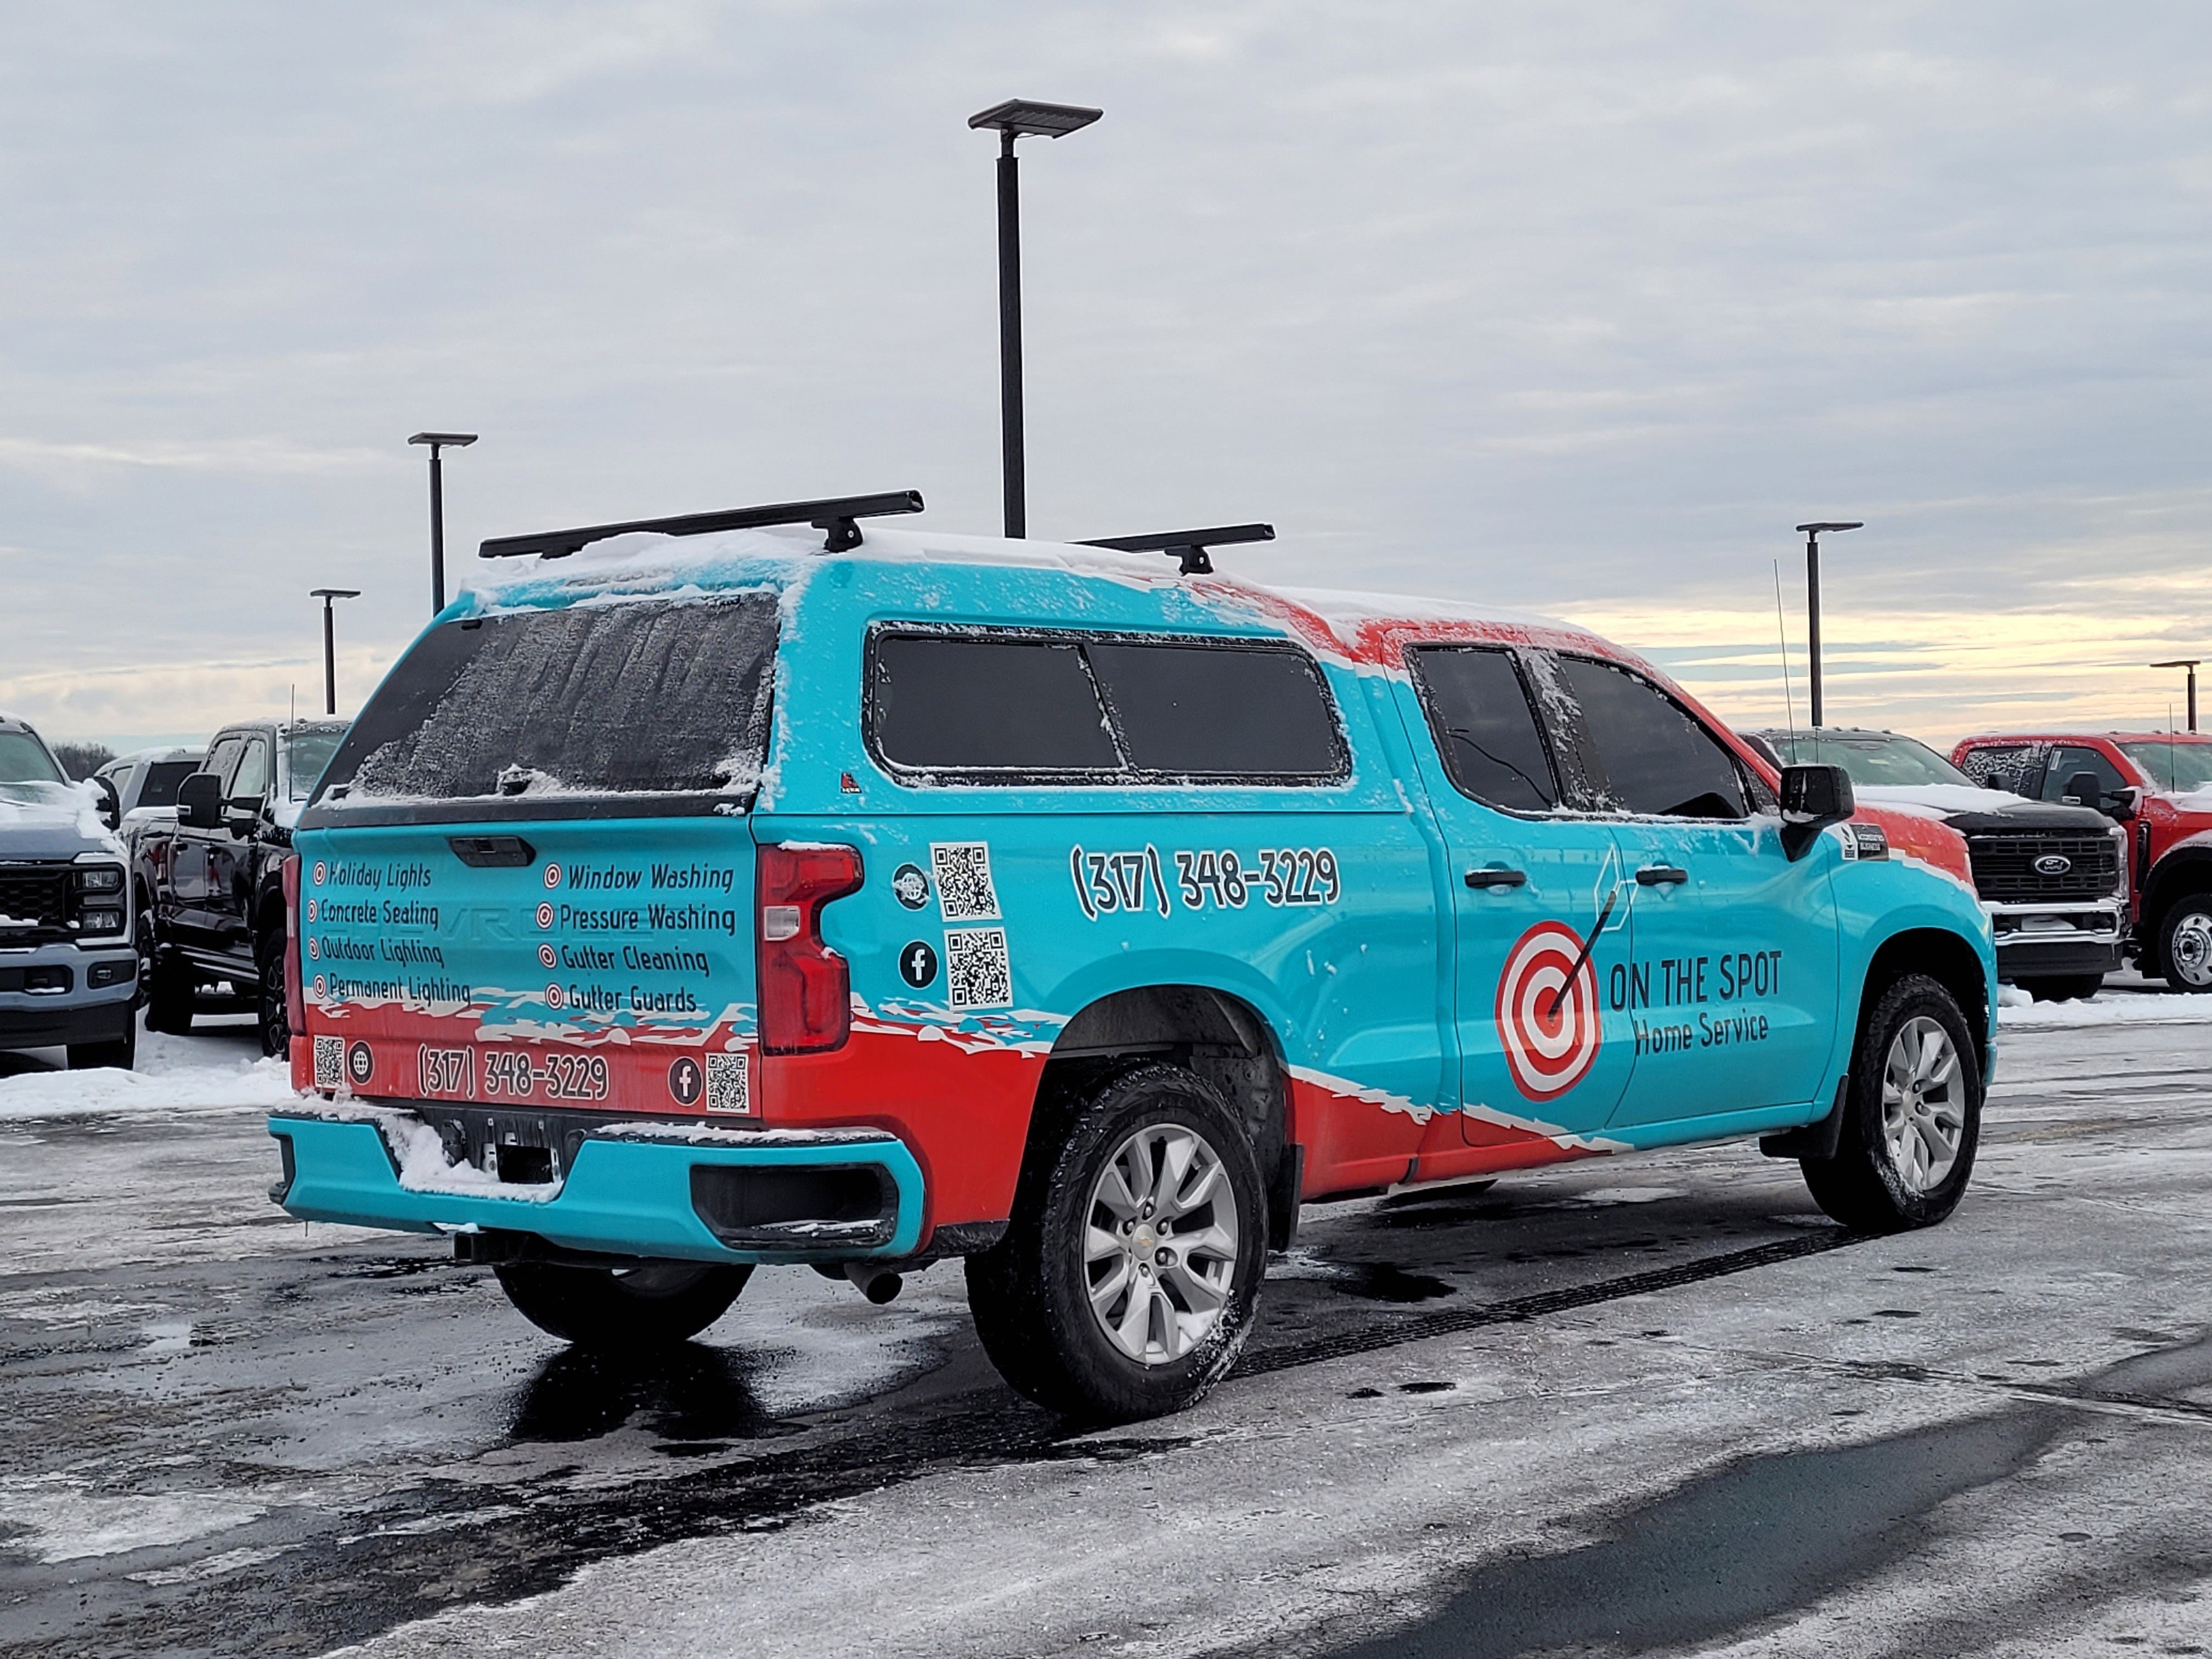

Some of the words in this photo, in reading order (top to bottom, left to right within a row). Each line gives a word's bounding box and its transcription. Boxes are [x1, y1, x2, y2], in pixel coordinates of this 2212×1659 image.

[329, 862, 381, 891] Holiday
[387, 862, 431, 892] Lights
[568, 864, 642, 889] Window
[651, 863, 734, 894] Washing
[1070, 843, 1170, 921] (317)
[1175, 848, 1341, 910] 348-3229
[321, 899, 377, 923] Concrete
[383, 900, 438, 931] Sealing
[561, 904, 639, 930] Pressure
[648, 904, 736, 936] Washing
[321, 936, 375, 961] Outdoor
[380, 938, 445, 968] Lighting
[561, 945, 614, 970] Gutter
[623, 946, 709, 977] Cleaning
[330, 973, 403, 999] Permanent
[409, 977, 471, 1007] Lighting
[1610, 962, 1650, 1011] ON
[1661, 956, 1709, 1006] THE
[1719, 951, 1782, 1000] SPOT
[569, 984, 622, 1011] Gutter
[630, 986, 697, 1012] Guards
[1634, 1019, 1692, 1056] Home
[1700, 1008, 1769, 1046] Service
[419, 1044, 475, 1099] (317)
[485, 1052, 609, 1100] 348-3229
